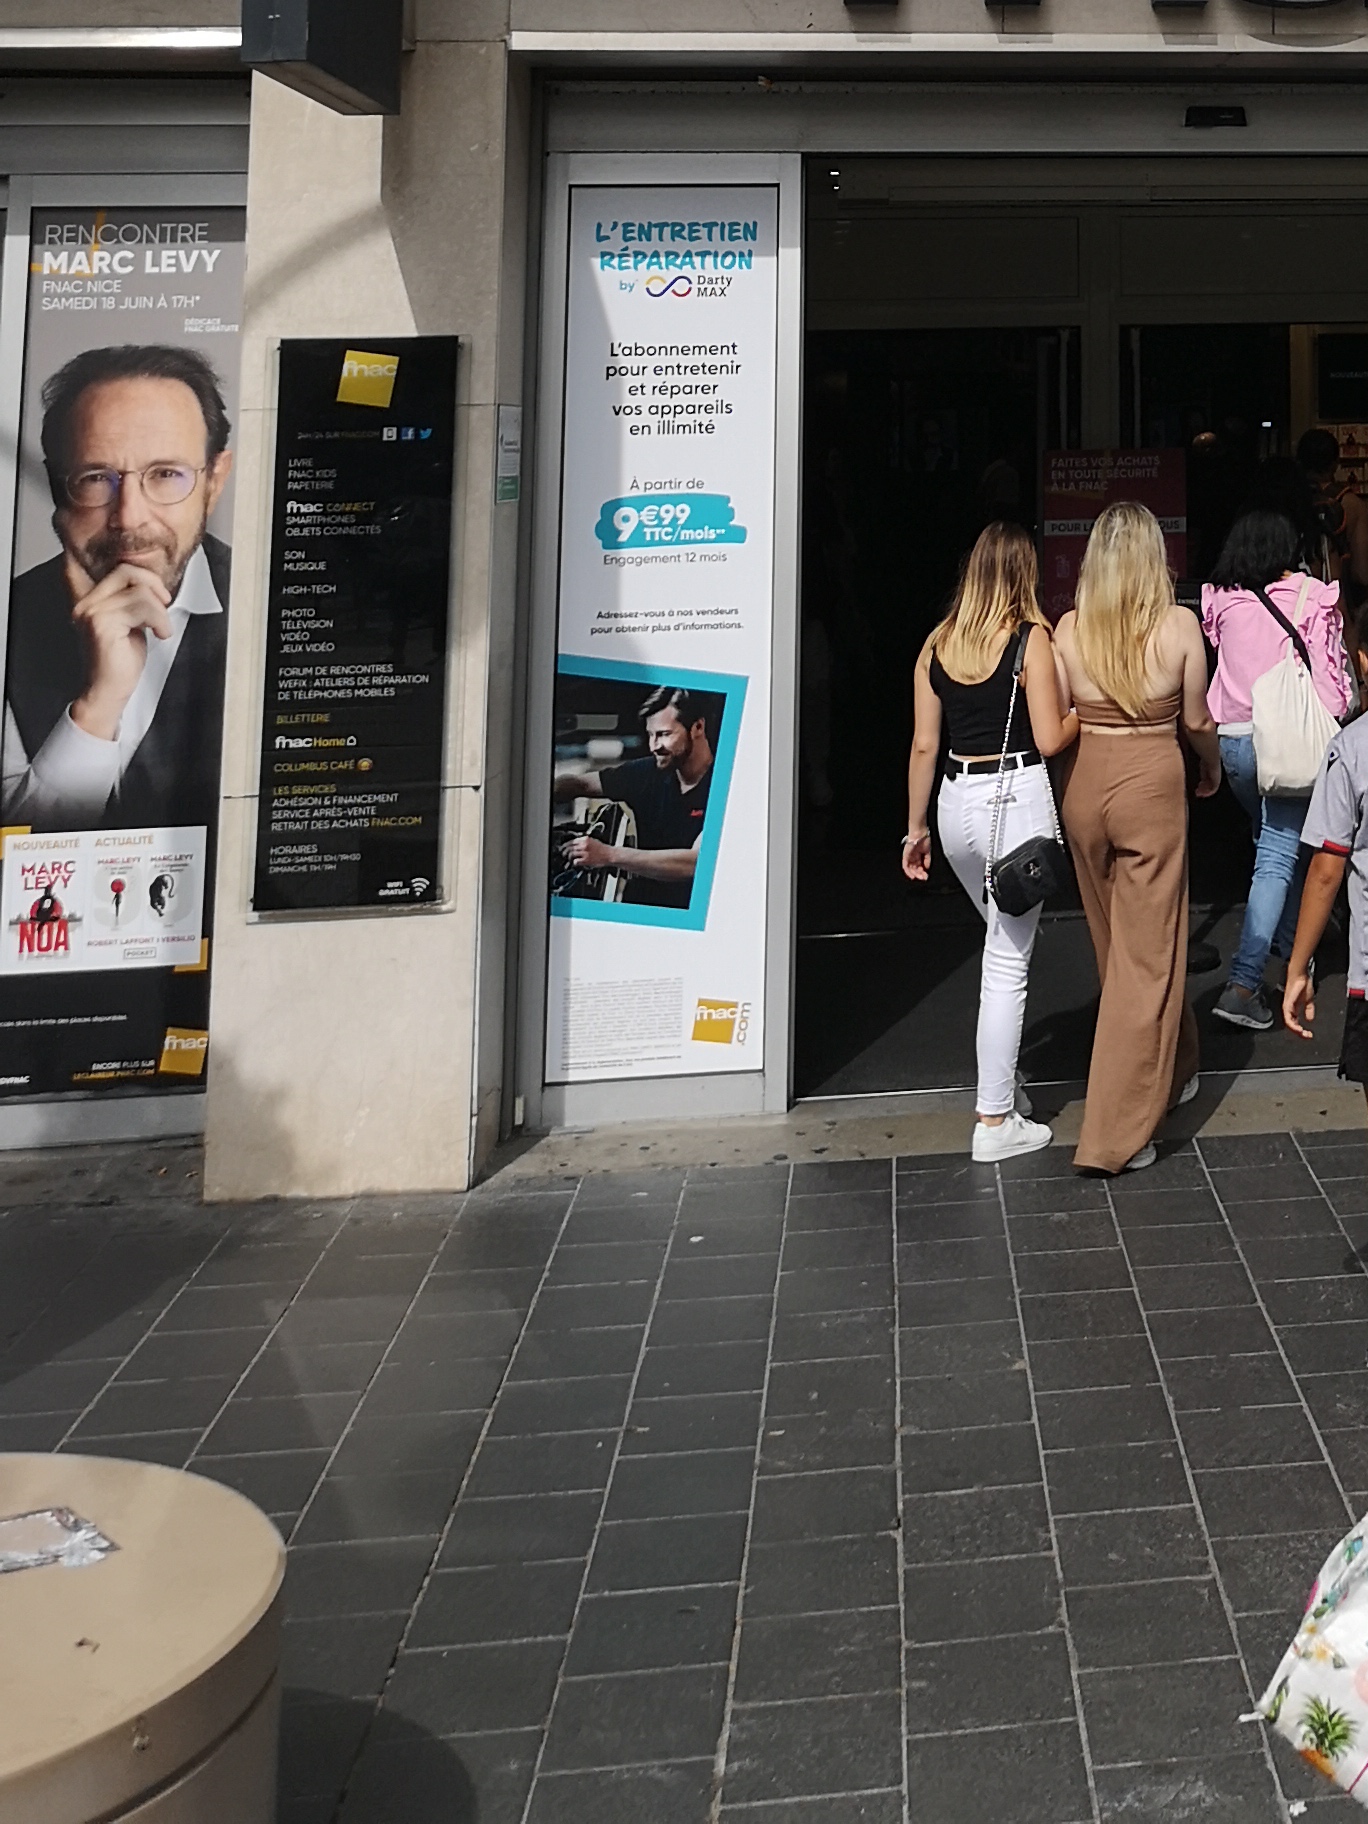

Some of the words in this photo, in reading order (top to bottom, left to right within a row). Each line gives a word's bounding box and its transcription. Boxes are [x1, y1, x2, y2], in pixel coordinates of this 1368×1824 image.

[45, 223, 209, 245] RENCONTRE
[596, 221, 757, 242] L'ENTRETIEN
[43, 251, 134, 274] MARC
[145, 250, 221, 273] LEVY
[600, 246, 753, 271] RÉPARATION
[42, 281, 82, 293] FNAC
[87, 280, 122, 292] NICE
[697, 275, 732, 287] Darty
[697, 287, 727, 297] MAX
[42, 297, 97, 310] SAMEDI
[102, 297, 115, 309] 18
[120, 296, 153, 309] JUIN
[157, 293, 168, 308] À
[610, 342, 738, 357] L'abonnement
[343, 360, 397, 376] fnac
[606, 365, 648, 380] pour
[653, 360, 741, 376] entretenir
[628, 384, 646, 396] et
[652, 381, 718, 399] réparer
[612, 405, 642, 416] vos
[648, 400, 733, 418] appareils
[629, 425, 651, 435] en
[657, 419, 716, 435] illimité
[288, 458, 313, 467] LIVRE
[1051, 458, 1088, 467] FAITES
[1091, 457, 1114, 466] VOS
[1116, 456, 1160, 465] ACHATS
[288, 470, 314, 478] FNAC
[316, 469, 337, 477] KIDS
[1051, 470, 1067, 479] EN
[1069, 469, 1104, 479] TOUTE
[1106, 467, 1158, 478] SÉCURITÉ
[288, 481, 334, 490] PAPETERIE
[630, 476, 640, 490] À
[644, 478, 682, 492] partir
[686, 478, 704, 489] de
[1051, 481, 1058, 491] À
[1063, 482, 1077, 491] LA
[1079, 481, 1108, 490] FNAC
[286, 501, 323, 513] fnac
[326, 502, 375, 511] CONNECT
[286, 515, 356, 524] SMARTPHONES
[285, 527, 321, 536] OBJETS
[323, 525, 381, 535] CONNECTÉS
[1051, 523, 1080, 532] POUR
[284, 551, 305, 559] SON
[603, 553, 681, 567] Engagement
[685, 553, 696, 562] 12
[700, 552, 727, 562] mois
[284, 562, 326, 571] MUSIQUE
[282, 585, 336, 594] HIGH-TECH
[281, 609, 315, 617] PHOTO
[597, 609, 665, 619] Adressez-vous
[668, 609, 674, 617] à
[677, 608, 693, 616] nos
[697, 608, 738, 616] vendeurs
[591, 626, 612, 636] pour
[615, 624, 649, 633] obtenir
[652, 623, 671, 633] plus
[280, 632, 309, 641] VIDÉO
[280, 644, 303, 653] JEUX
[306, 643, 335, 652] VIDÉO
[278, 668, 312, 676] FORUM
[315, 667, 326, 675] DE
[330, 664, 393, 674] RENCONTRES
[313, 678, 355, 686] ATELIERS
[357, 677, 369, 685] DE
[372, 675, 429, 684] RÉPARATION
[278, 691, 290, 700] DE
[293, 689, 352, 699] TÉLÉPHONES
[355, 688, 395, 697] MOBILES
[276, 713, 330, 724] BILLETTERIE
[274, 763, 328, 772] COLUMBUS
[330, 759, 355, 769] CAFÉ
[273, 786, 289, 795] LES
[292, 784, 336, 794] SERVICES
[272, 795, 321, 807] ADHÉSION
[324, 796, 330, 805] &
[332, 793, 398, 804] FINANCEMENT
[272, 809, 310, 819] SERVICE
[271, 821, 308, 831] RETRAIT
[311, 820, 329, 829] DES
[332, 819, 369, 828] ACHATS
[371, 817, 422, 826] FNAC.COM
[13, 839, 80, 851] NOUVEAUTÉ
[95, 835, 153, 847] ACTUALITÉ
[270, 844, 318, 854] HORAIRES
[21, 861, 76, 876] MARC
[24, 875, 72, 891] LEVY
[19, 920, 70, 954] NOA
[696, 1006, 738, 1020] fnac
[164, 1035, 207, 1050] fnac
